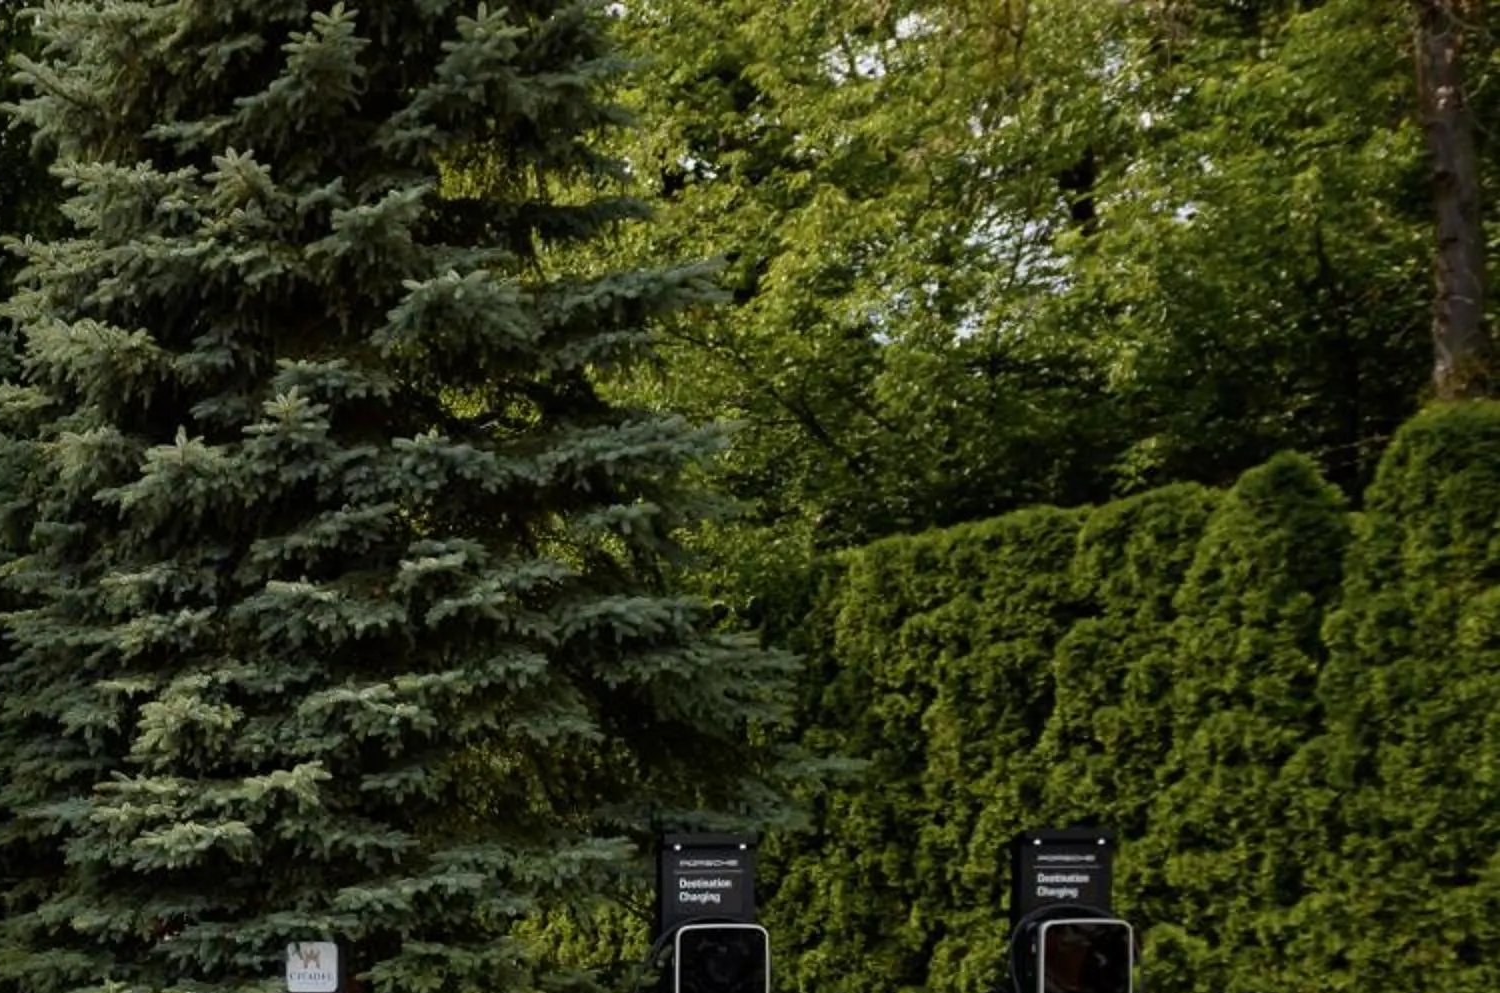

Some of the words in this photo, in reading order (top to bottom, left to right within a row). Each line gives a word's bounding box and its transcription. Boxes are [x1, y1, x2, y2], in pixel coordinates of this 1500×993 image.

[679, 859, 738, 867] PORSCHE
[679, 877, 732, 888] Destination
[1037, 873, 1090, 883] Destination
[679, 891, 721, 904] Charging
[1037, 886, 1078, 899] Charging
